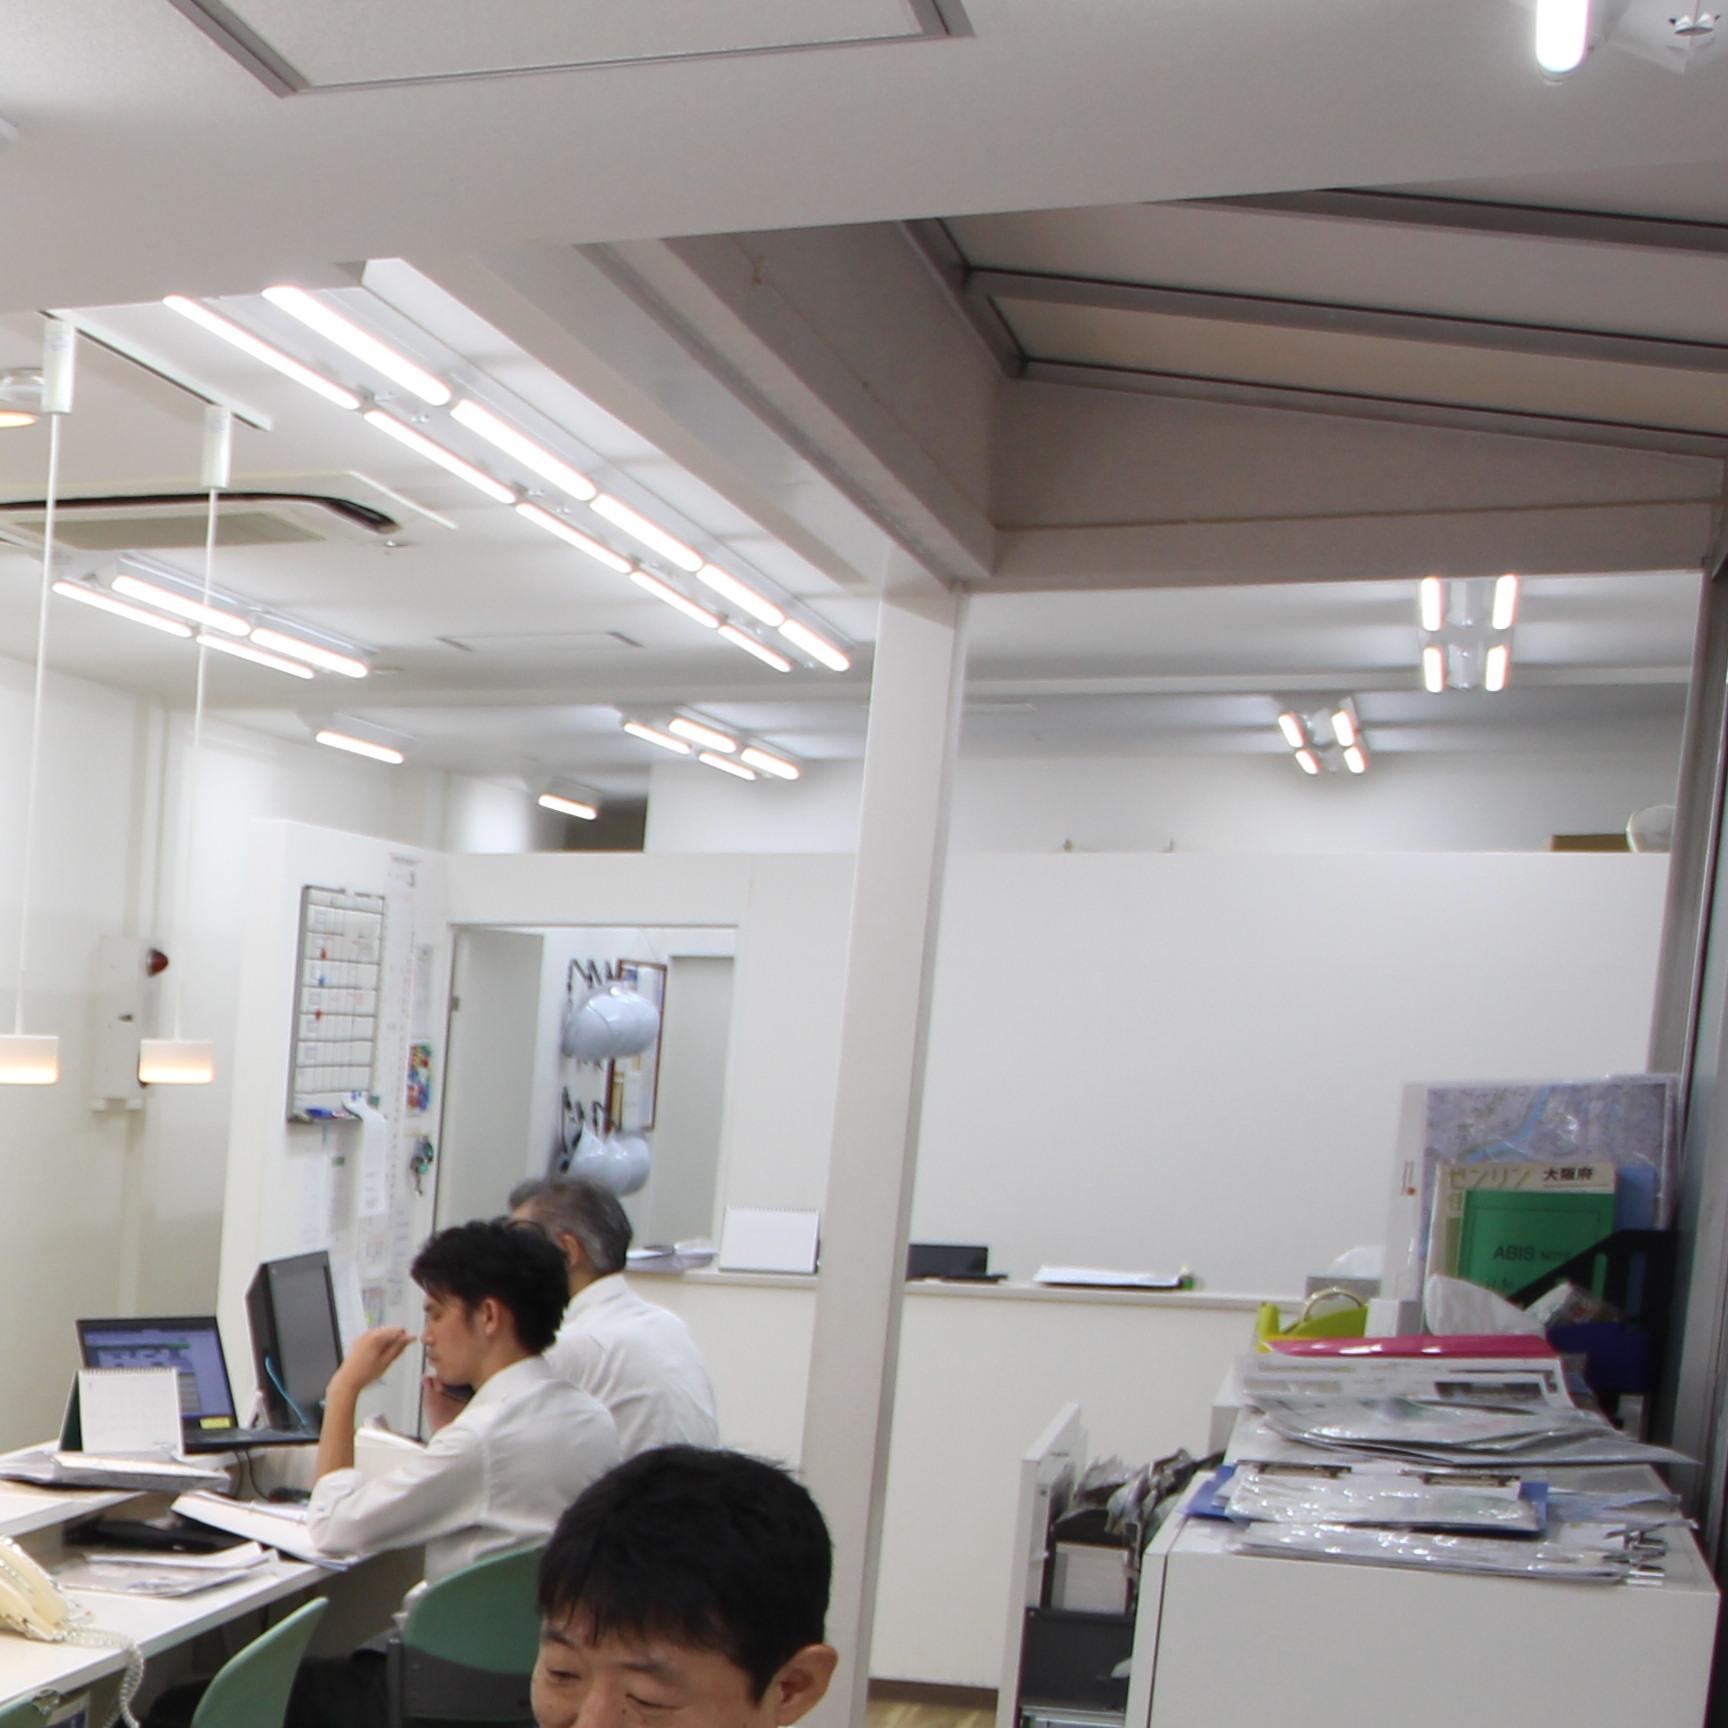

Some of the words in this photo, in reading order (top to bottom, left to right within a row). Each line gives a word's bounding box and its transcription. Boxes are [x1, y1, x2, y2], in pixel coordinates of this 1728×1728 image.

[1544, 1166, 1594, 1182] 大阪府
[1494, 1245, 1536, 1261] ABIS
